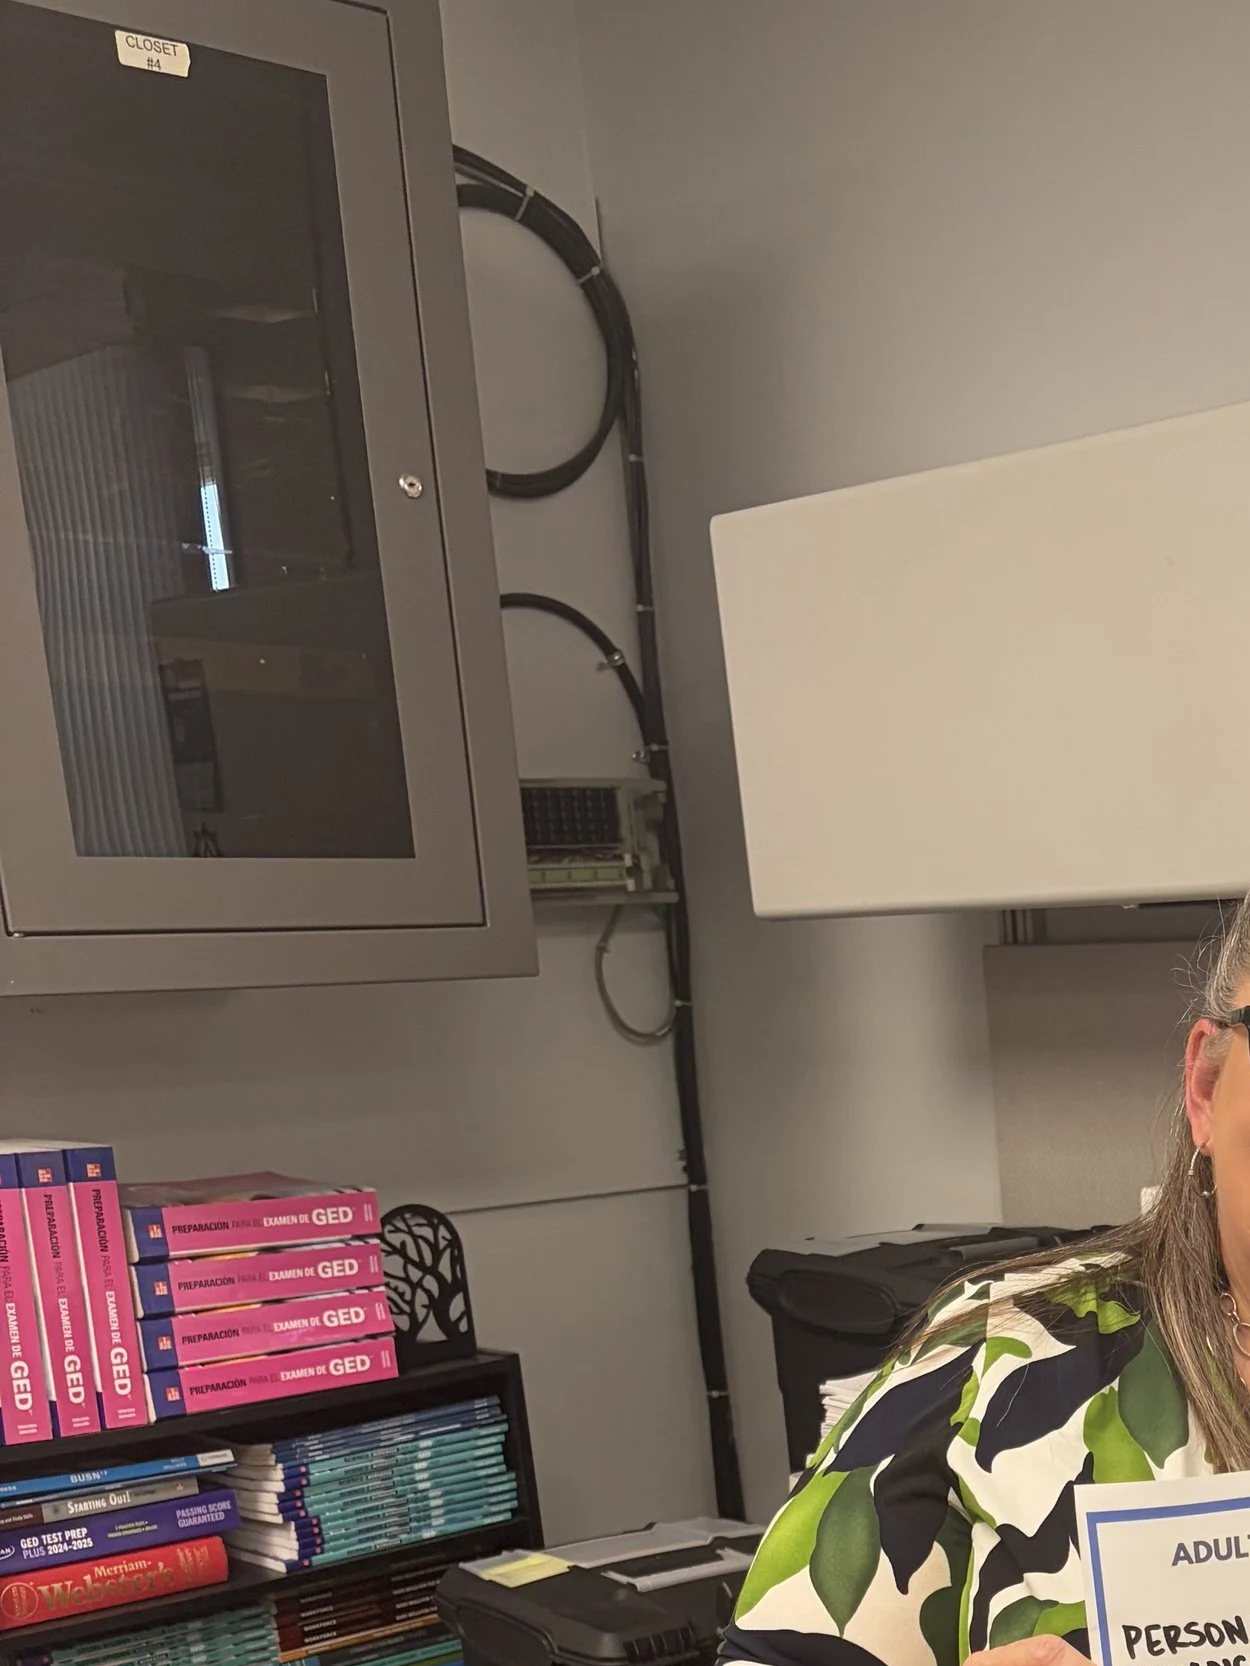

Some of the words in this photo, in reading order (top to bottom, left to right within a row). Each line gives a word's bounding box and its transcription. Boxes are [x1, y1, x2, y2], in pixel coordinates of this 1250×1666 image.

[125, 35, 178, 56] CLOSET
[147, 57, 161, 70] #4
[172, 1220, 229, 1234] PREPARACIÓN
[263, 1215, 297, 1227] EXAMEN
[299, 1214, 309, 1223] DE
[312, 1206, 353, 1225] GED
[178, 1277, 235, 1291] PREPARACIÓN
[269, 1269, 303, 1281] EXAMEN
[305, 1267, 315, 1277] DE
[317, 1259, 358, 1278] GED
[6, 1303, 20, 1344] EXAMEN
[59, 1298, 72, 1338] EXAMEN
[105, 1291, 120, 1331] EXAMEN
[112, 1332, 121, 1344] DE
[182, 1329, 239, 1344] PREPARACIÓN
[274, 1320, 308, 1332] EXAMEN
[310, 1317, 321, 1327] DE
[323, 1307, 365, 1327] GED
[13, 1345, 21, 1357] DE
[66, 1339, 74, 1352] DE
[11, 1361, 33, 1410] GED
[64, 1355, 85, 1404] GED
[110, 1347, 131, 1396] GED
[190, 1379, 247, 1395] PREPARACIÓN
[280, 1368, 315, 1381] EXAMEN
[316, 1365, 327, 1375] DE
[329, 1355, 370, 1376] GED
[176, 1505, 207, 1519] PASSING
[208, 1500, 232, 1512] SCORE
[178, 1511, 225, 1528] GUARANTEED
[20, 1536, 39, 1549] GED
[41, 1532, 62, 1545] TEST
[64, 1527, 88, 1541] PREP
[22, 1546, 46, 1559] PLUS
[47, 1537, 93, 1555] 2024-2025
[94, 1560, 152, 1579] Merriam-
[37, 1562, 175, 1611] Webster's
